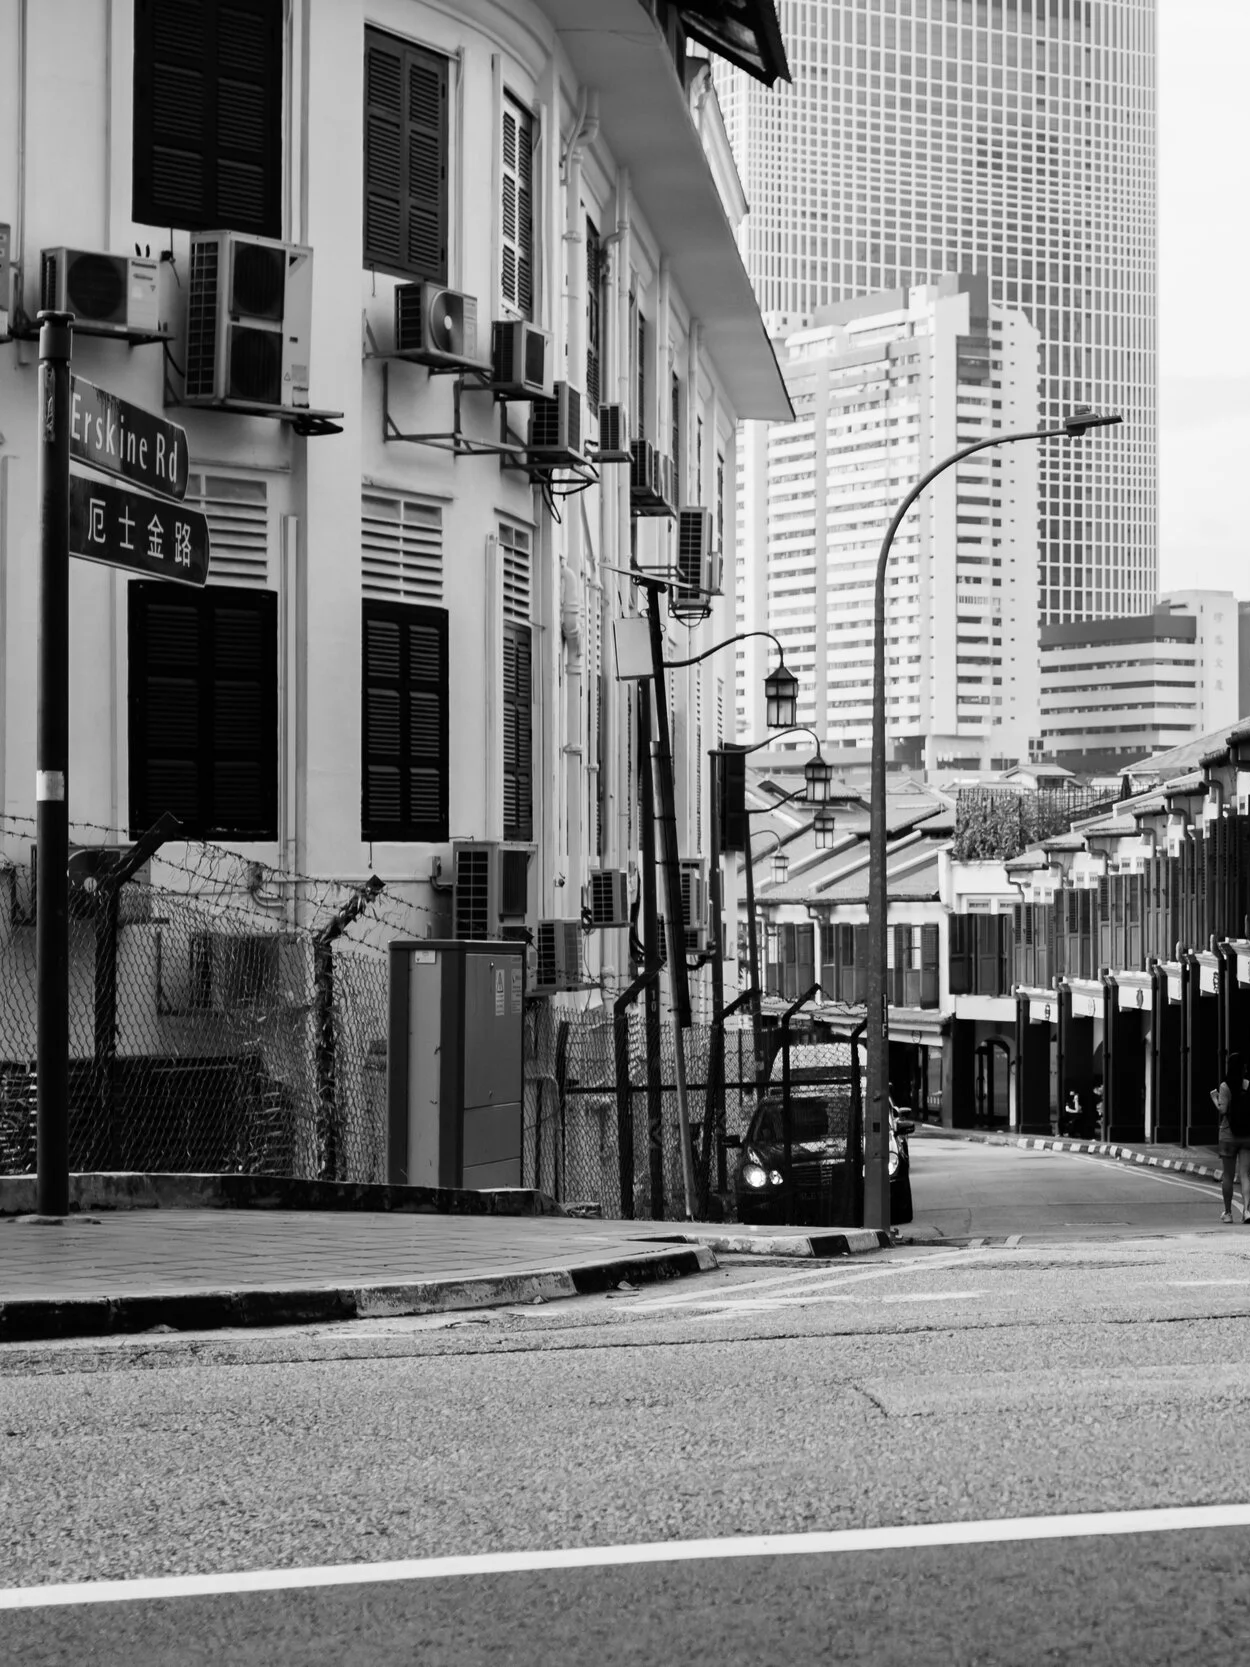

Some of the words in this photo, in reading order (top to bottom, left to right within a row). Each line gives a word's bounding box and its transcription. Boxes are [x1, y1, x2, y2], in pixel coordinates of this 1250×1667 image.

[71, 393, 148, 470] Erskine
[155, 432, 178, 484] Rd
[88, 498, 191, 567] 厄士金路
